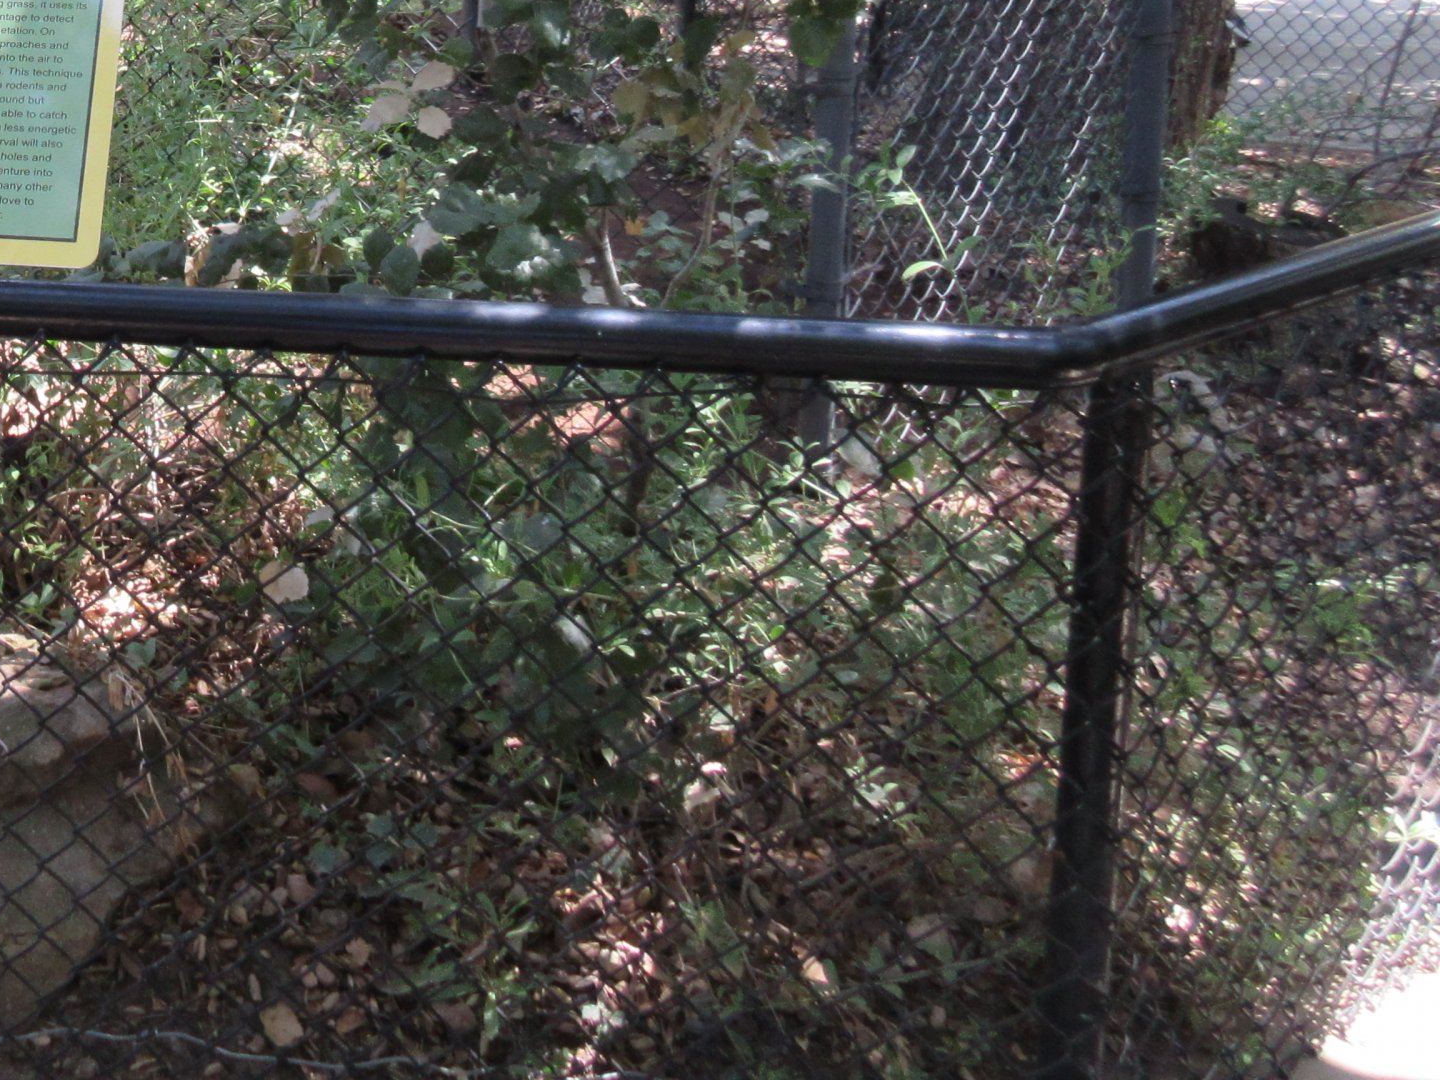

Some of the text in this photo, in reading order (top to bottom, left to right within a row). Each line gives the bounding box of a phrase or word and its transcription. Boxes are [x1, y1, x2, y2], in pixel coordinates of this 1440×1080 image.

[40, 0, 47, 8] it
[49, 1, 74, 9] uses
[75, 1, 87, 10] its
[30, 12, 40, 22] to
[42, 13, 74, 23] detect
[39, 26, 56, 36] On
[49, 41, 69, 50] and
[18, 53, 35, 62] the
[37, 54, 51, 63] air
[53, 54, 63, 63] to
[8, 66, 30, 76] This
[31, 67, 83, 79] technique
[3, 80, 44, 91] rodents
[46, 82, 67, 92] and
[27, 95, 45, 104] but
[1, 108, 23, 118] able
[25, 109, 37, 118] to
[39, 110, 68, 120] catch
[3, 122, 25, 132] less
[27, 124, 77, 136] energetic
[20, 138, 39, 147] will
[41, 138, 63, 148] also
[0, 151, 29, 161] holes
[31, 153, 52, 162] and
[33, 167, 53, 177] into
[24, 181, 53, 192] other
[24, 196, 35, 206] to
